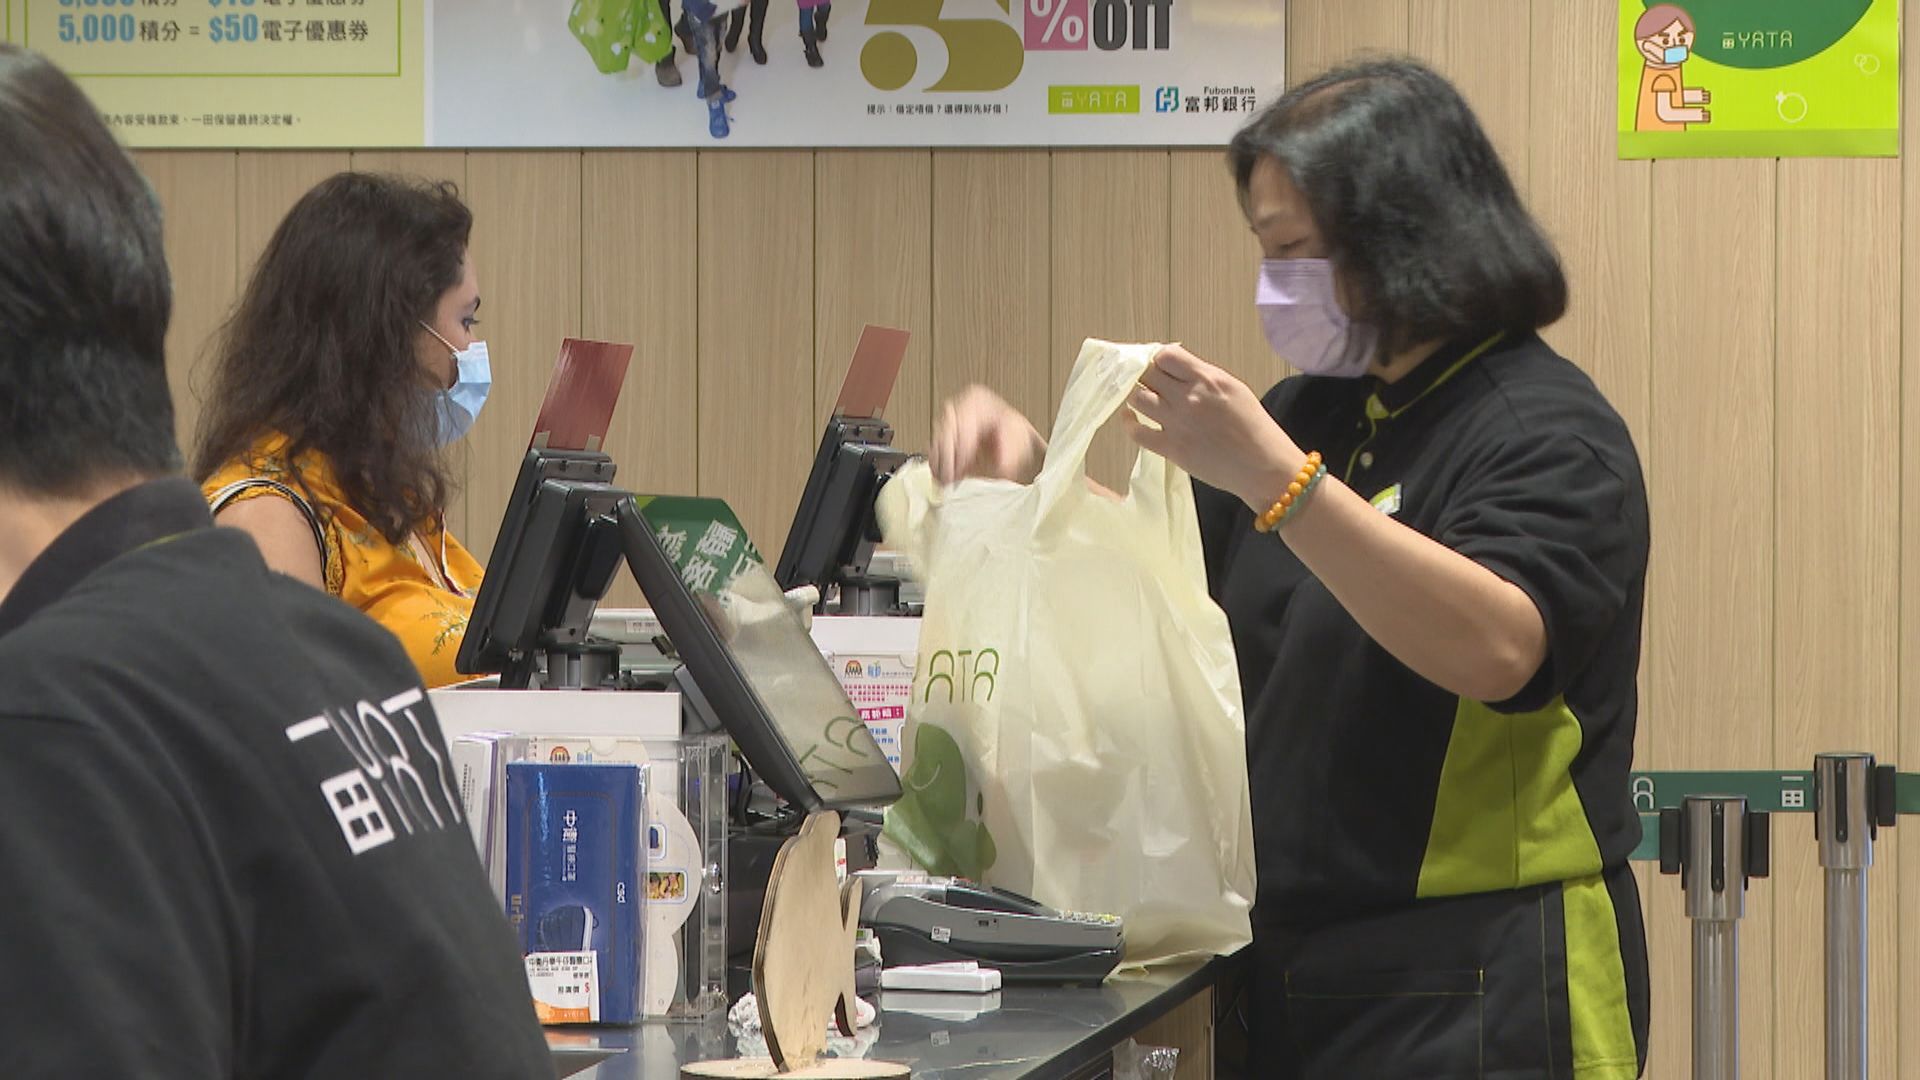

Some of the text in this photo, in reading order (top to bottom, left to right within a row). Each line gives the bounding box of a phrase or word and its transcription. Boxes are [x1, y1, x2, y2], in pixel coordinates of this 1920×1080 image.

[58, 14, 135, 44] 5,000
[140, 20, 180, 42] 積分
[208, 14, 258, 43] $50
[262, 20, 369, 42] 電子優惠券
[1738, 30, 1793, 48] YATA
[1203, 86, 1256, 95] Fubon Bank
[1076, 91, 1128, 109] YATA
[1185, 96, 1256, 113] 富邦銀行
[923, 647, 1000, 704] ATA
[322, 686, 463, 835] YAT
